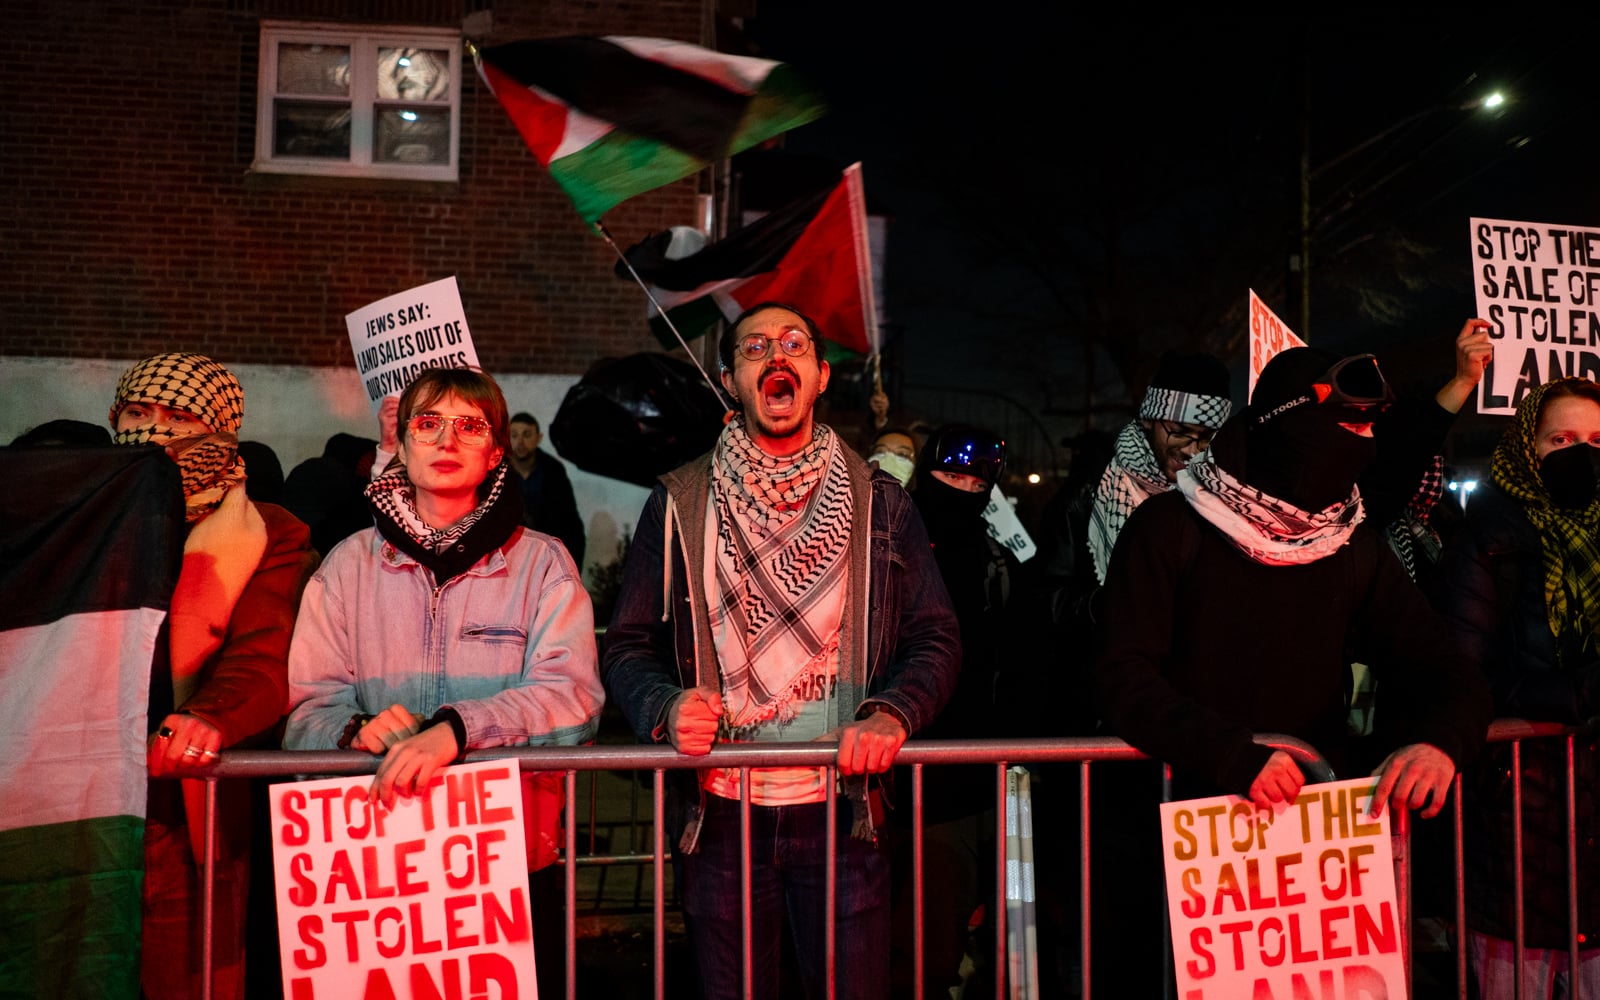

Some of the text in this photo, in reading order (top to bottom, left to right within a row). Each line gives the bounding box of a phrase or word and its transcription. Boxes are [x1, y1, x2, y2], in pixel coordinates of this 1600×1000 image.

[1477, 223, 1600, 268] STOP THE
[1483, 264, 1600, 306] SALE OF
[357, 320, 463, 375] LAND SALES OUT OF
[366, 302, 431, 339] JEWS SAY:
[366, 376, 383, 401] OUR
[420, 767, 516, 833] THE
[1173, 785, 1383, 861] STOP THE
[288, 829, 507, 907] SALE OF
[1181, 844, 1375, 919] SALE OF
[293, 886, 531, 970] STOLEN
[1186, 901, 1398, 980] STOLEN
